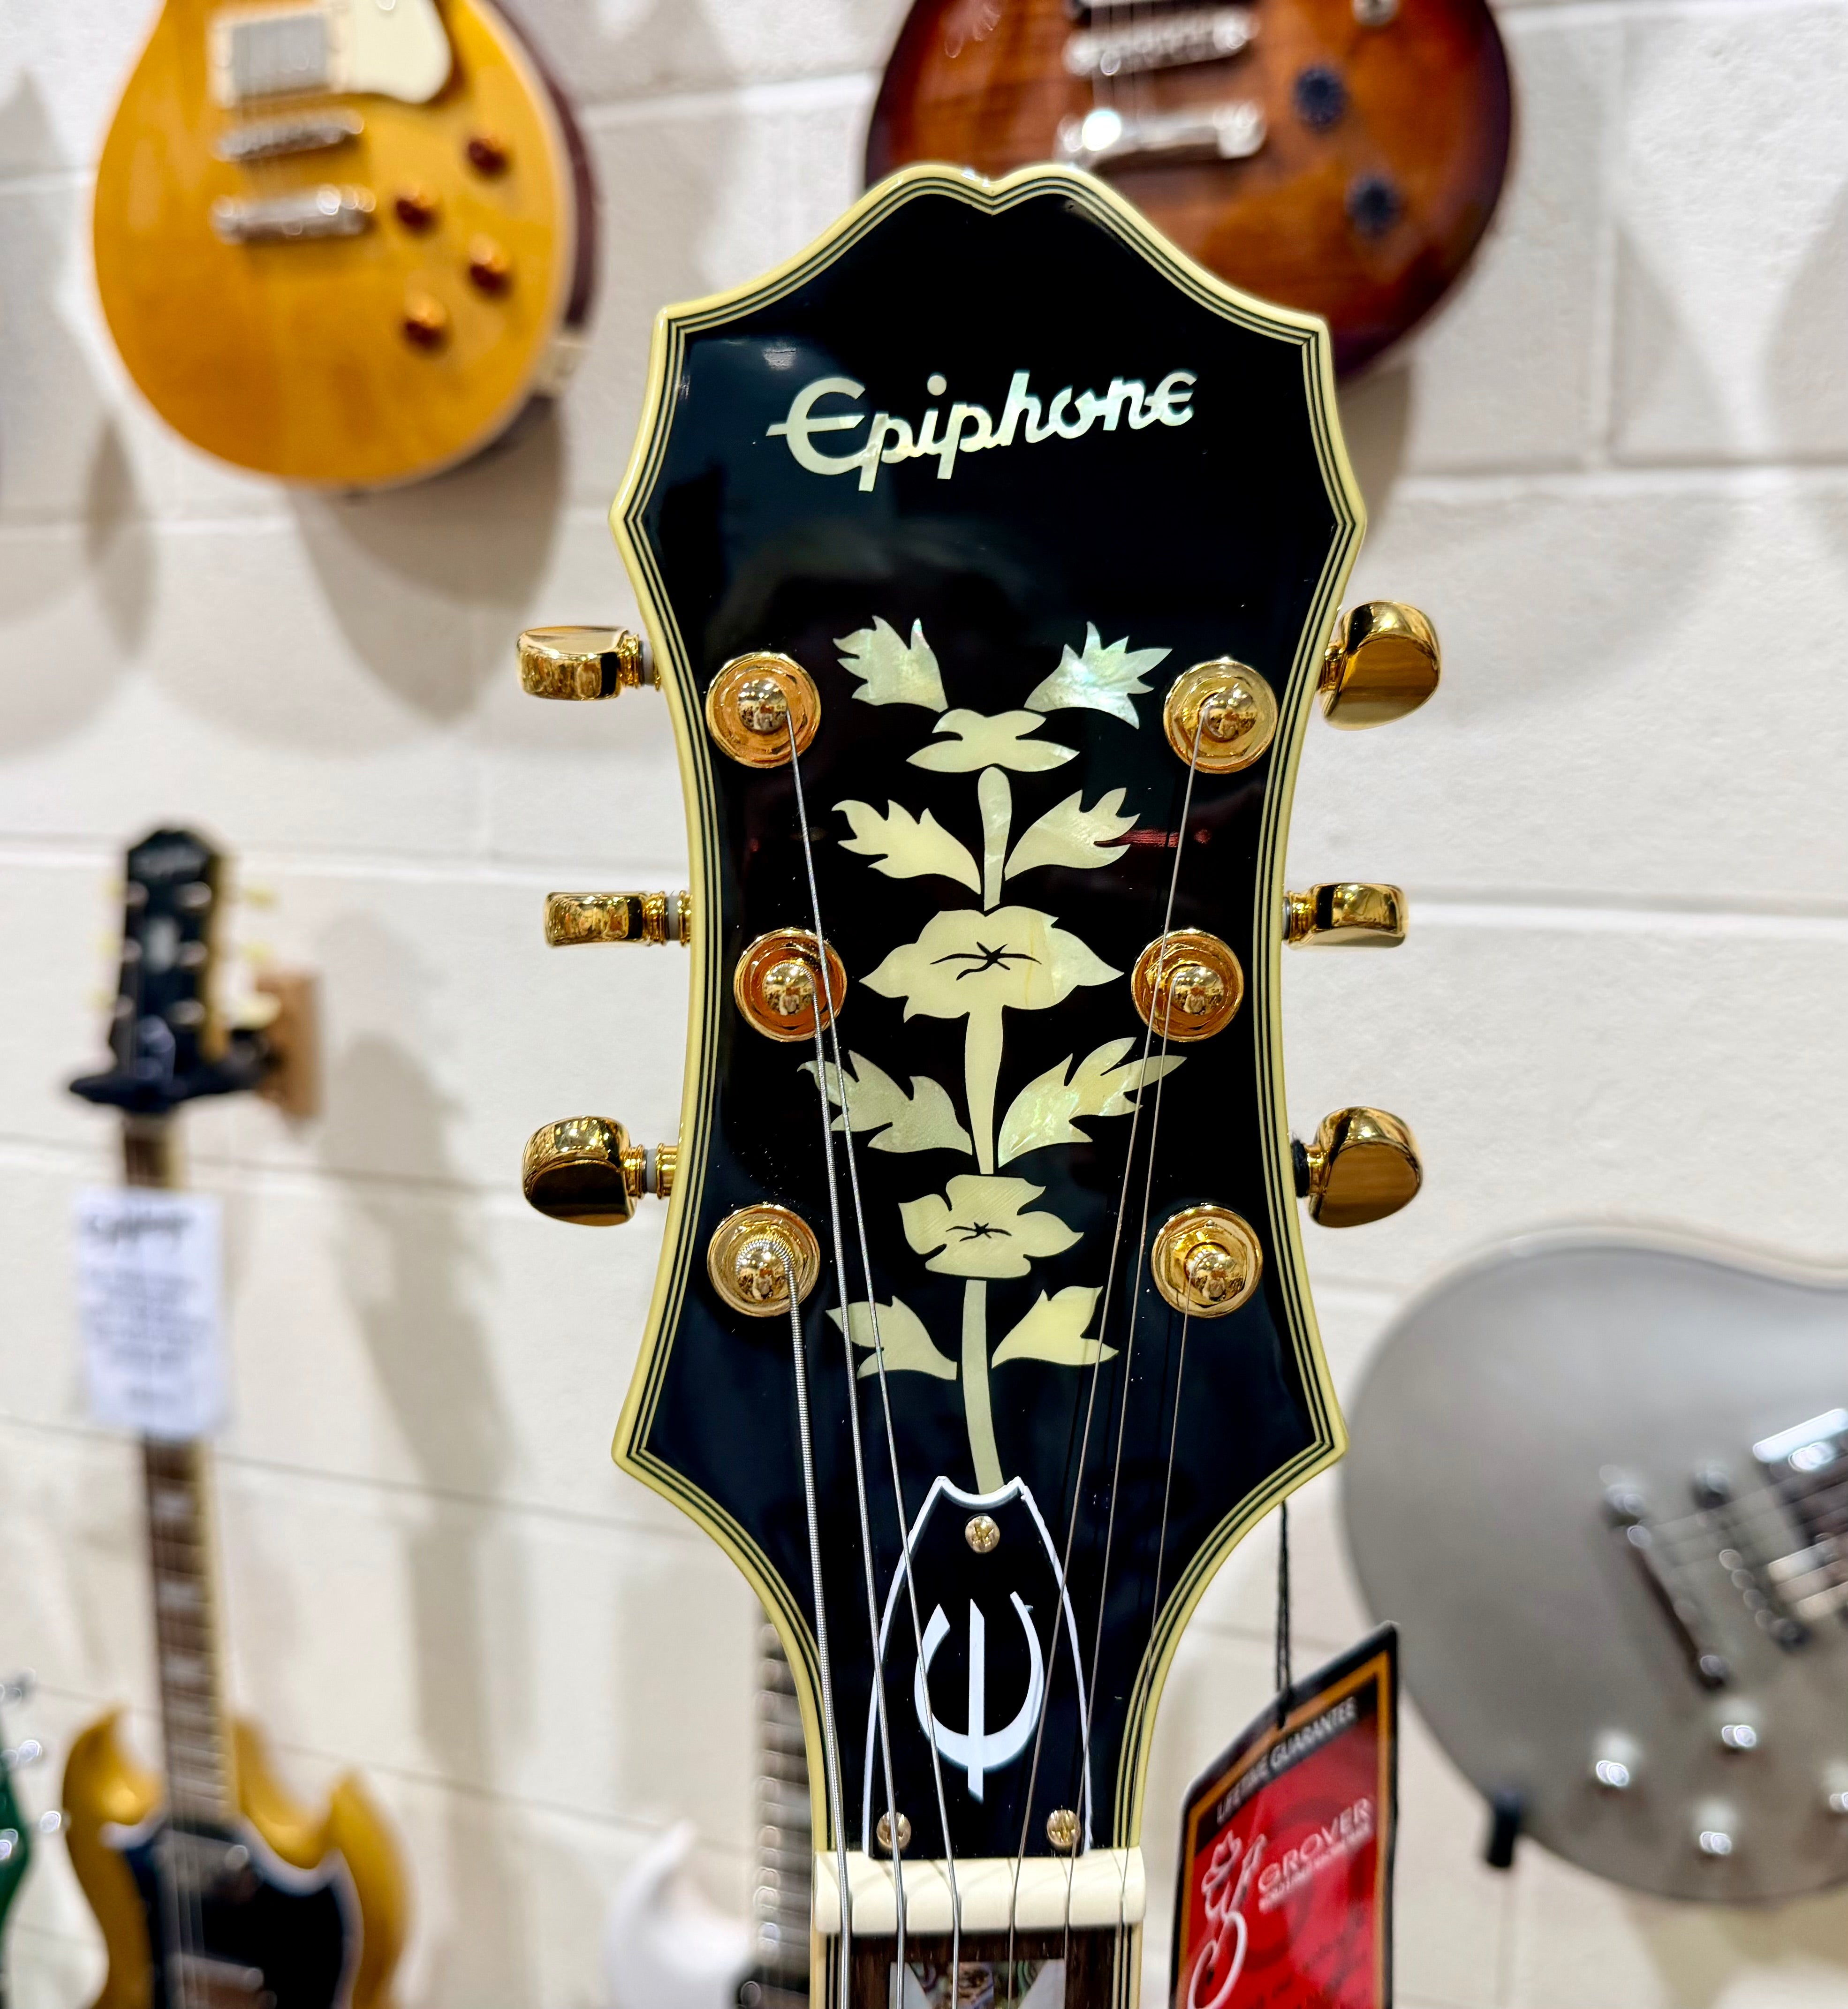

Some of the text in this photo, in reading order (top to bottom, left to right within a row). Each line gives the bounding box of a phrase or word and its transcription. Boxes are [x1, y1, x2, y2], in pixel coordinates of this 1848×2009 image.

[765, 369, 1197, 492] Epiphone
[1269, 1695, 1357, 1769] GUARANTEE
[1257, 1797, 1372, 1894] GROVER
